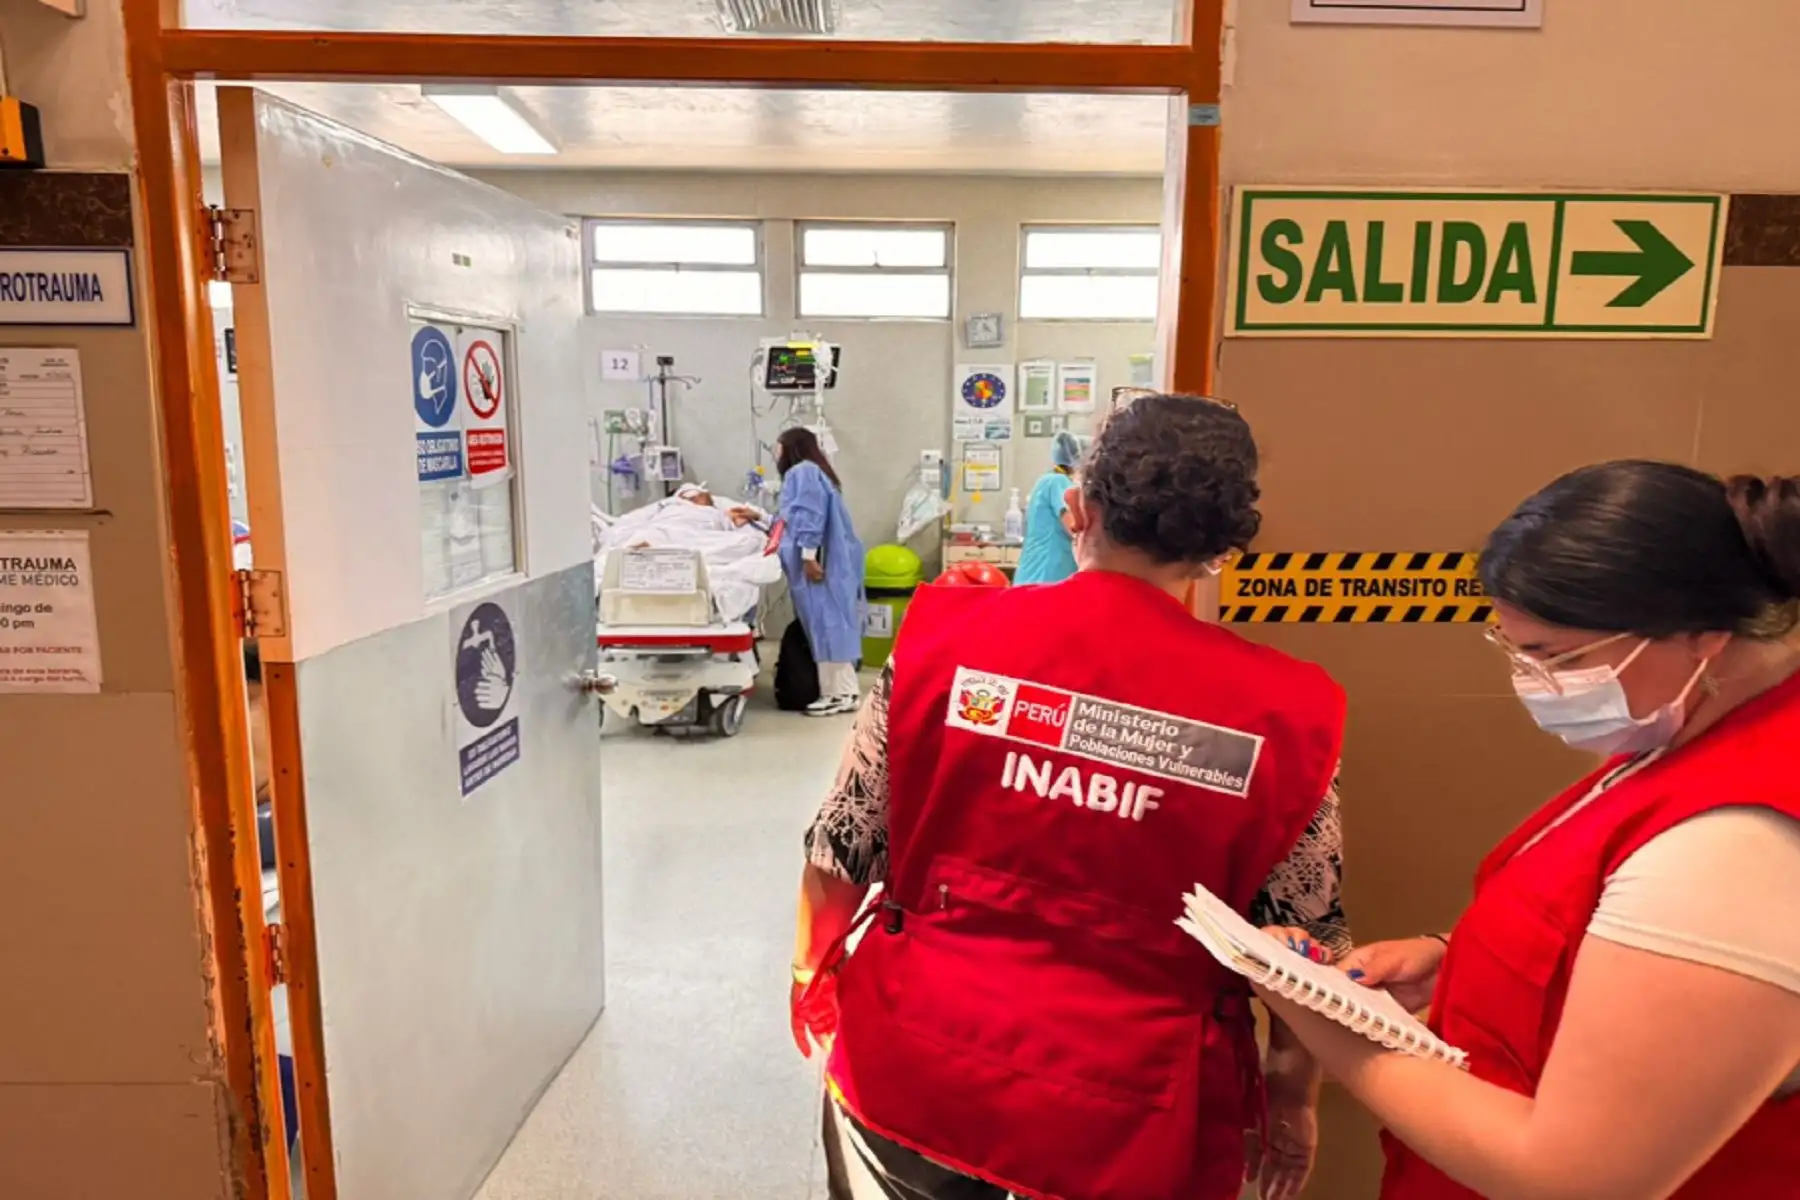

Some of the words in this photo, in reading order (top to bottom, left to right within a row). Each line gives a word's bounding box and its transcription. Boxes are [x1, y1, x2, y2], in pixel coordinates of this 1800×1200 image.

[1256, 218, 1538, 304] SALIDA
[0, 272, 104, 302] ROTRAUMA
[612, 357, 629, 371] 12
[0, 557, 77, 570] TRAUMA
[22, 571, 79, 587] MÉDICO
[1237, 578, 1297, 597] ZONA
[1304, 578, 1332, 597] DE
[1340, 578, 1447, 597] TRANSITO
[1454, 578, 1489, 597] RE
[0, 602, 31, 616] ingo
[34, 602, 53, 613] de
[13, 620, 35, 630] pm
[1013, 700, 1067, 728] PERÚ
[1078, 702, 1180, 737] Ministerio
[1073, 717, 1097, 734] de
[1100, 721, 1117, 739] la
[1119, 727, 1178, 753] Mujer
[1179, 745, 1194, 759] y
[1069, 734, 1155, 767] Poblaciones
[1158, 755, 1244, 788] Vulnerables
[1000, 751, 1166, 822] INABIF
